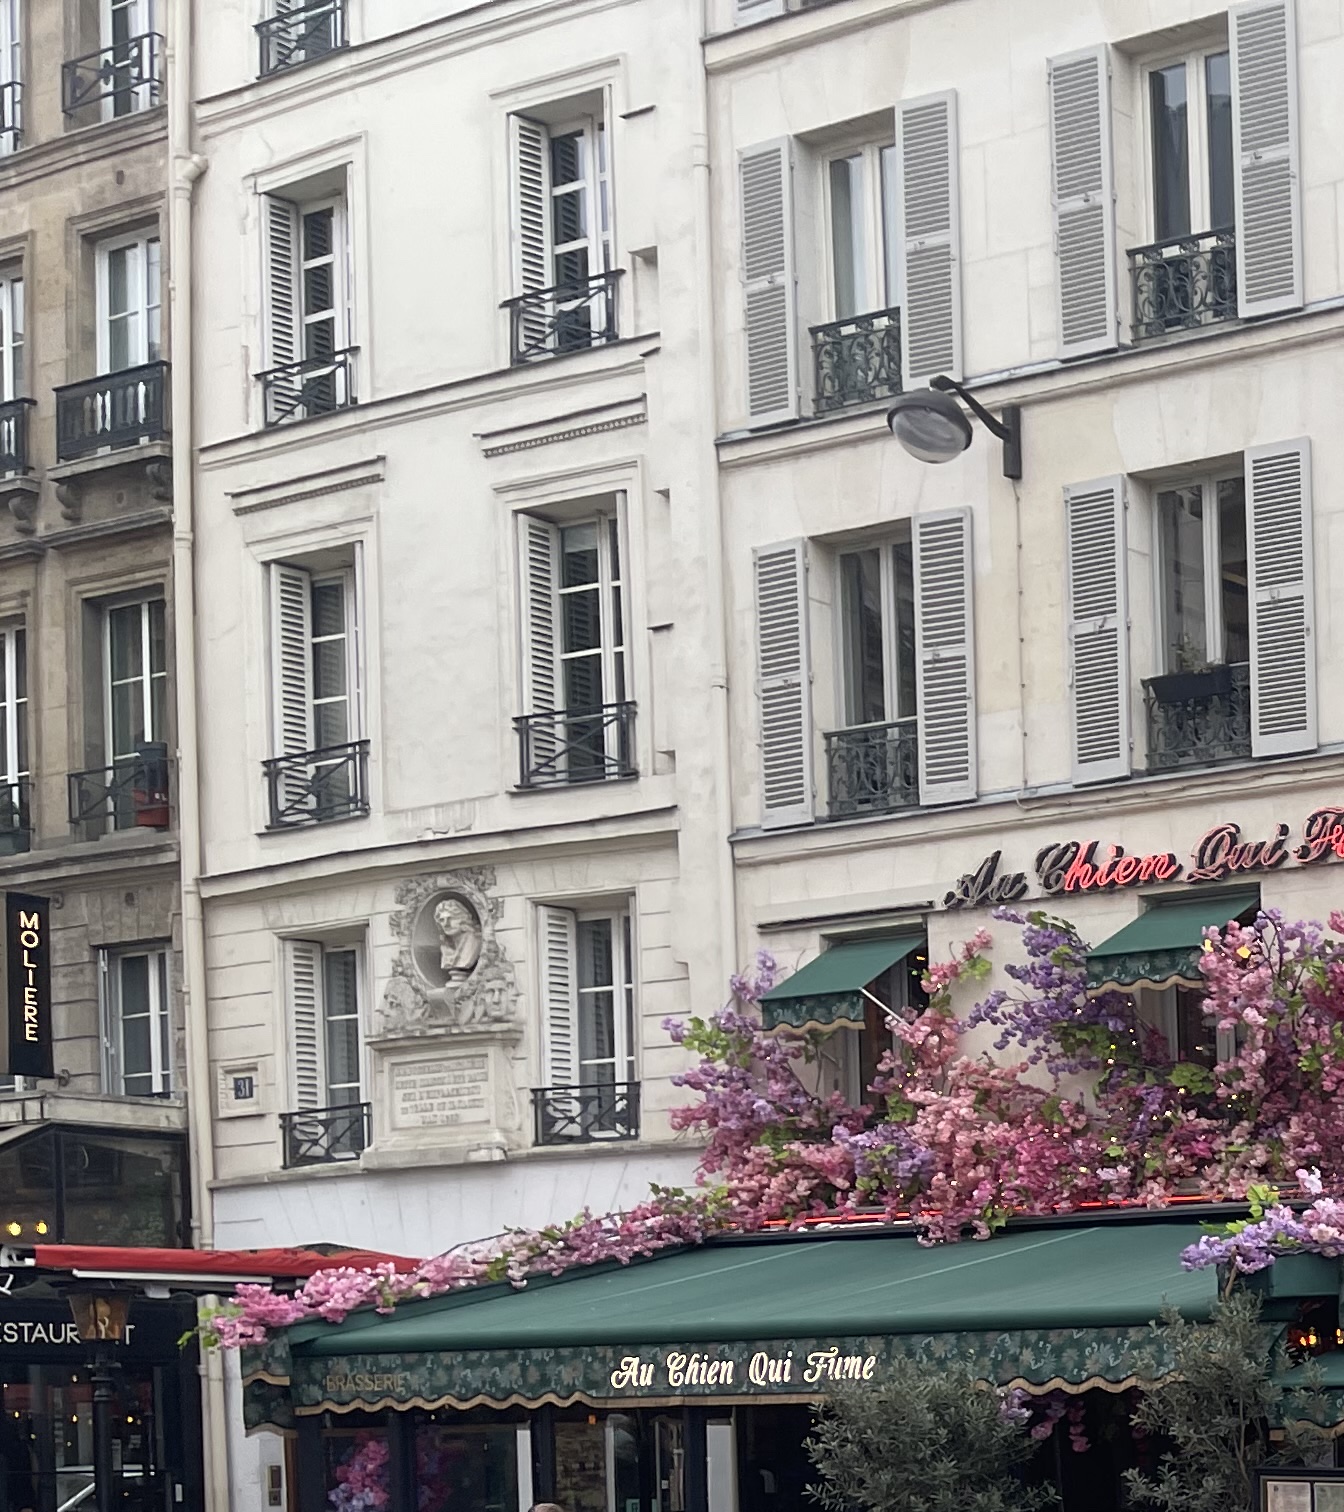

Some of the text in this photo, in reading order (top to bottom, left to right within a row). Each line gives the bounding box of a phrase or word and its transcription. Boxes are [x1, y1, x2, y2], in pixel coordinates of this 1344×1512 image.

[943, 850, 1028, 908] Au
[1035, 840, 1182, 895] Chien
[1185, 823, 1289, 882] Qui
[19, 910, 40, 1043] MOLIERE
[236, 1080, 250, 1098] 31
[326, 1373, 405, 1393] BRASSERIE
[610, 1346, 877, 1389] Au Chien Qui Fume
